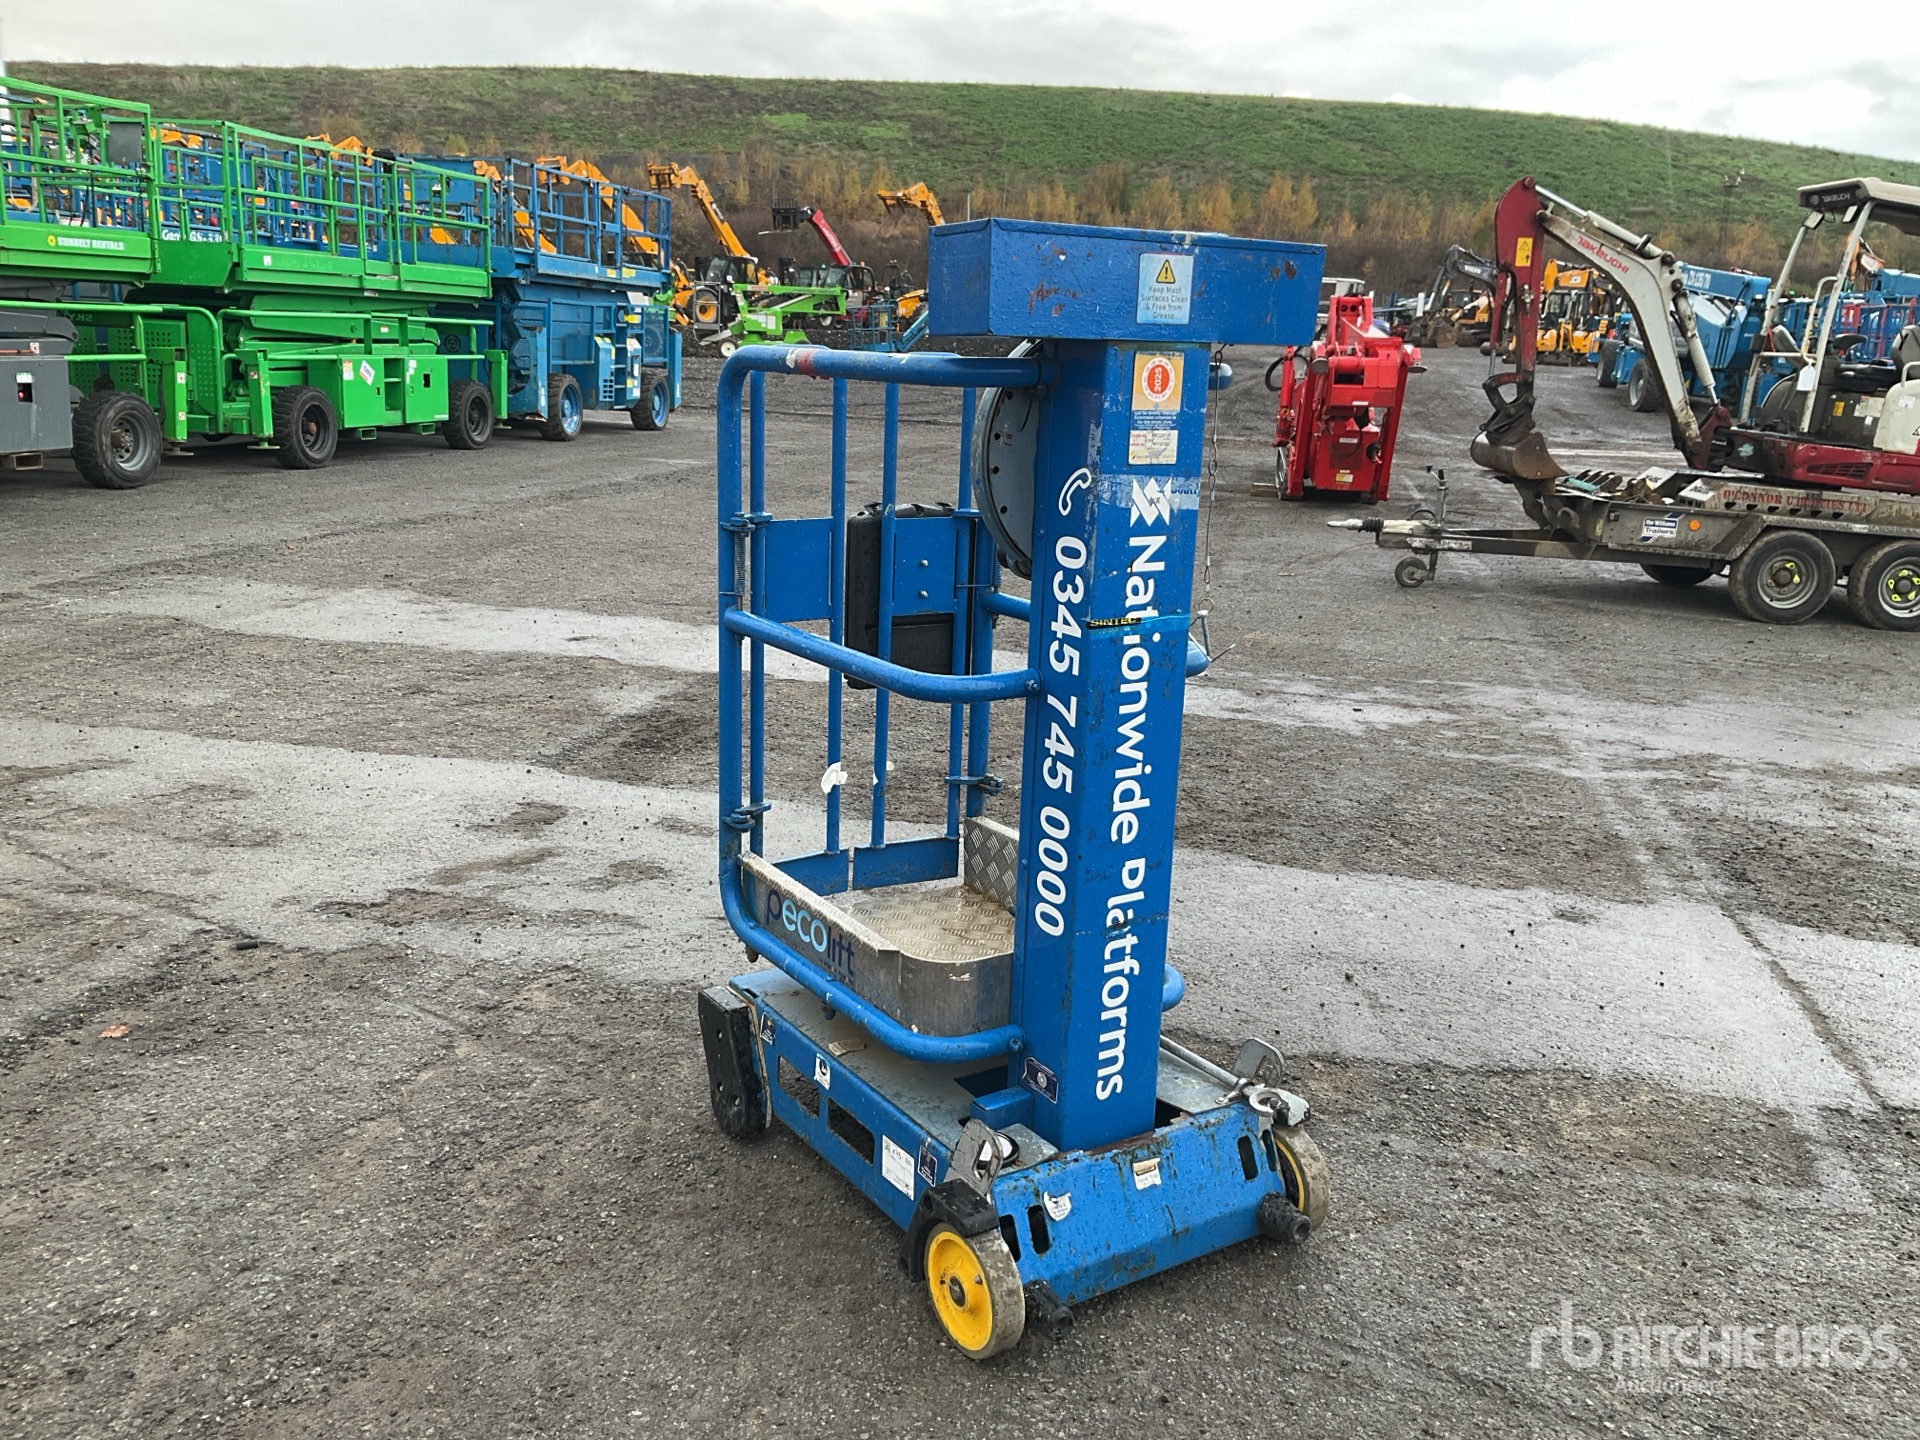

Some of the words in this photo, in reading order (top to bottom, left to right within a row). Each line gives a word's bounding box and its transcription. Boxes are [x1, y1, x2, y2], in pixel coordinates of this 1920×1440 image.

[57, 236, 91, 249] SUNBELT
[91, 239, 125, 251] RENTALS
[1577, 235, 1630, 274] TAKEUCHI
[1140, 294, 1170, 303] Surfaces
[1170, 295, 1189, 303] Clean
[1148, 286, 1165, 295] Keep
[1166, 286, 1182, 294] Mast
[1151, 303, 1167, 311] Free
[1167, 303, 1183, 311] from
[1152, 311, 1175, 319] Grease
[1153, 366, 1163, 393] 2025
[1722, 488, 1783, 506] O'CONNOR
[1645, 527, 1674, 535] Trailers
[1049, 536, 1087, 677] 0345
[1089, 617, 1137, 627] SINTEC
[1110, 535, 1168, 844] Nationwide
[1043, 694, 1077, 795] 745
[1034, 805, 1070, 937] 0000
[765, 888, 855, 976] pecolift
[1095, 857, 1146, 1101] Platforms
